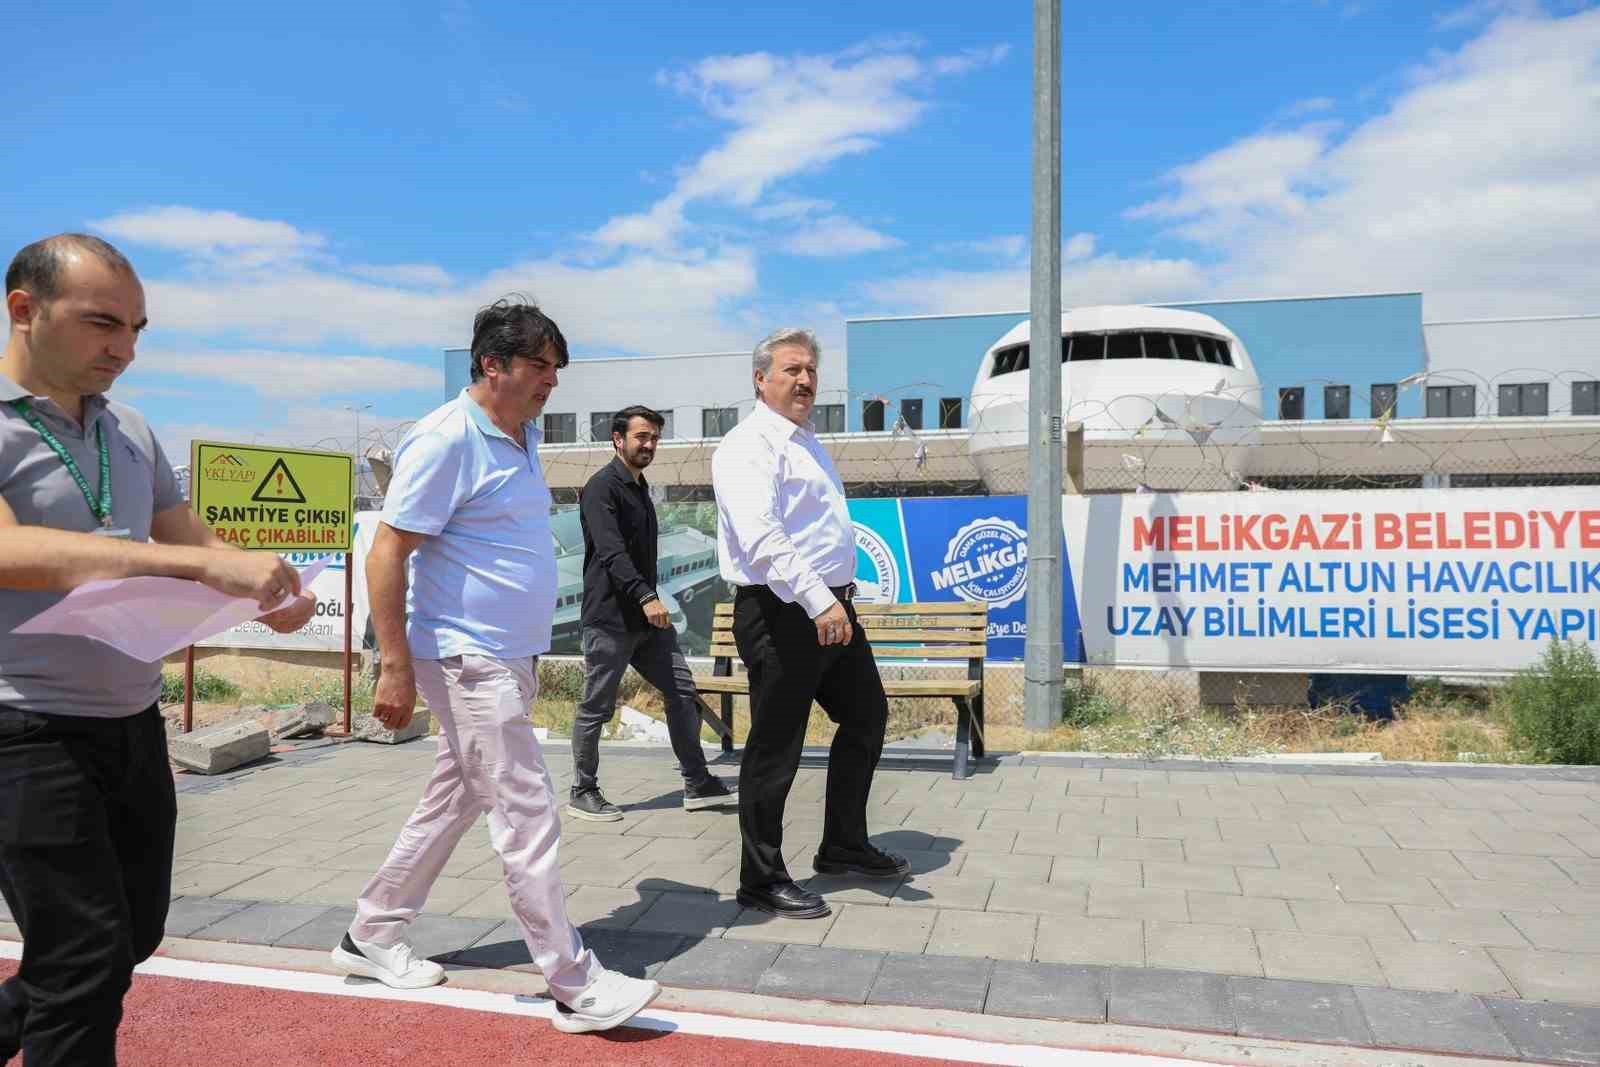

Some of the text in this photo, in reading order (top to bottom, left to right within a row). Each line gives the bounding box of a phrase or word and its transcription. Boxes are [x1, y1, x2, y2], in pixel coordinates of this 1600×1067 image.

[206, 504, 346, 527] ŞANTİYE ÇIKIŞI
[215, 527, 250, 546] RAÇ
[256, 526, 336, 547] ÇIKABİLİR
[1123, 560, 1600, 594] MEHMET ALTUN HAVACILIK
[1107, 597, 1600, 641] UZAY BİLİMLERİ LİSESİ YAPI
